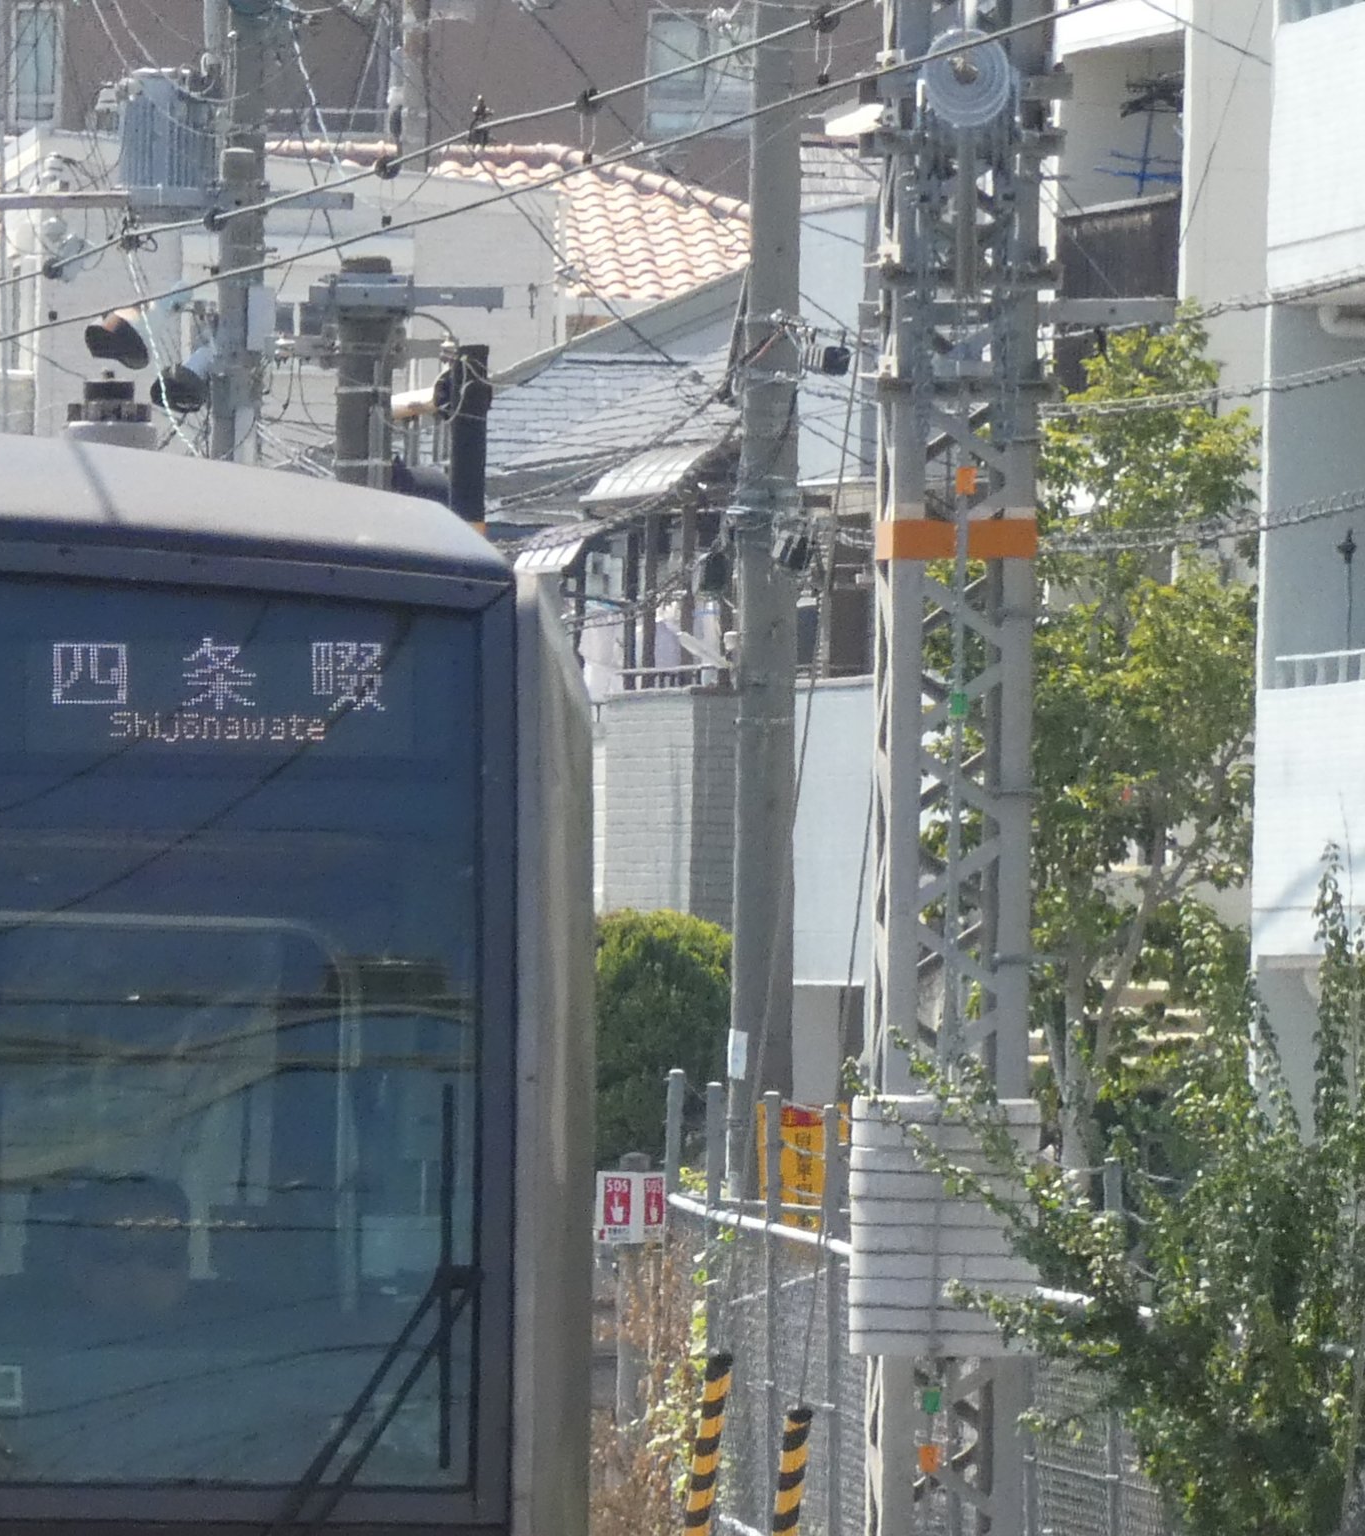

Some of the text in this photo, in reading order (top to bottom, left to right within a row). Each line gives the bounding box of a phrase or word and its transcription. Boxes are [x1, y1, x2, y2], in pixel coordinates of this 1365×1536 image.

[53, 639, 386, 711] 四条畷
[606, 1180, 629, 1193] SOS
